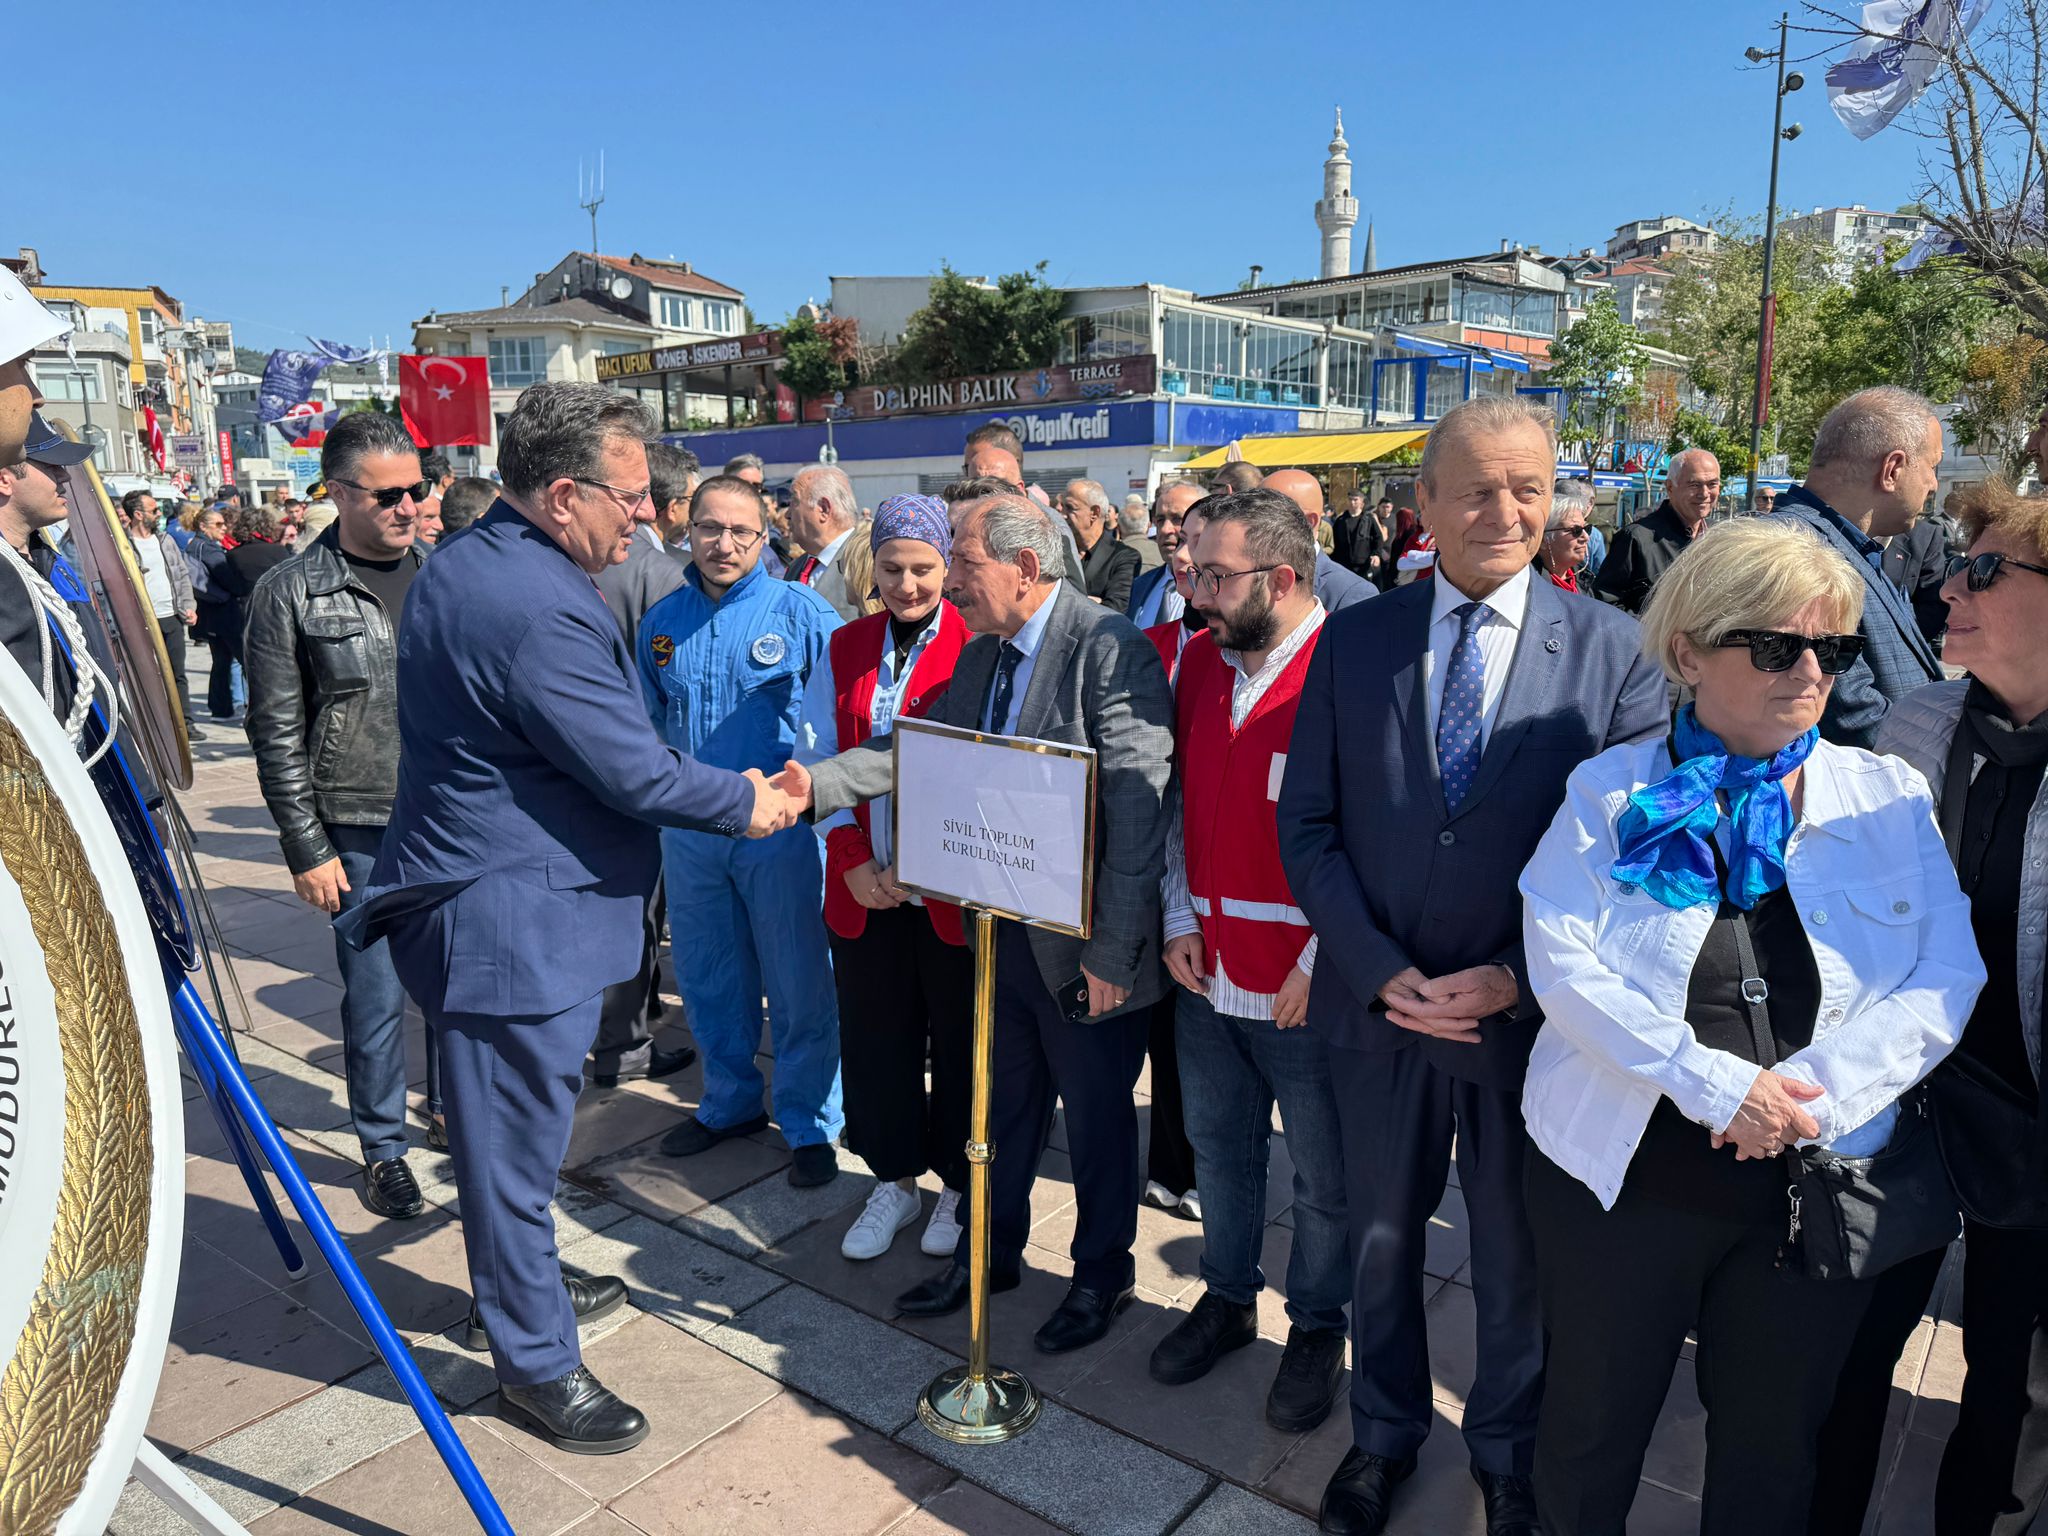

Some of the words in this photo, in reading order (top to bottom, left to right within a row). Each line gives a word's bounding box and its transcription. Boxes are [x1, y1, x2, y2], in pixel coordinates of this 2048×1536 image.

[597, 357, 620, 376] HACI
[622, 353, 653, 373] UFUK
[1070, 363, 1122, 382] TERRACE
[873, 383, 954, 411] DOLPHIN
[960, 377, 1017, 404] BALIK
[943, 818, 977, 838] SİVİL
[978, 826, 1035, 851] TOPLUM
[942, 839, 1036, 872] KURULUŞLARI
